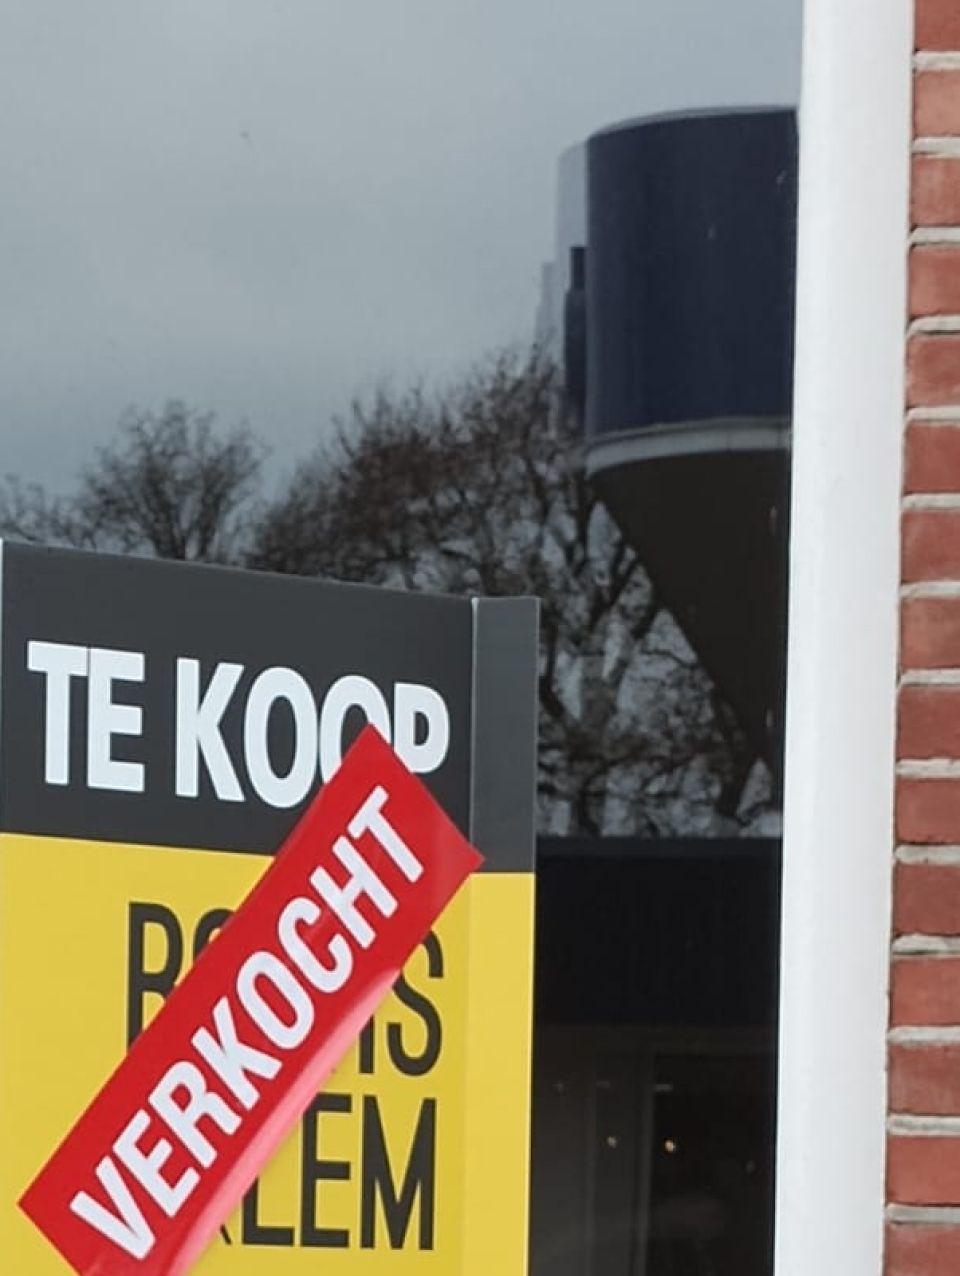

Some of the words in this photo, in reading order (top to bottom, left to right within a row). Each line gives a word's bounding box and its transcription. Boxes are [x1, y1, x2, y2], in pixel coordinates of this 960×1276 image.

[27, 640, 144, 792] TE
[175, 657, 450, 808] KOOP
[69, 785, 424, 1260] VERKOCHT
